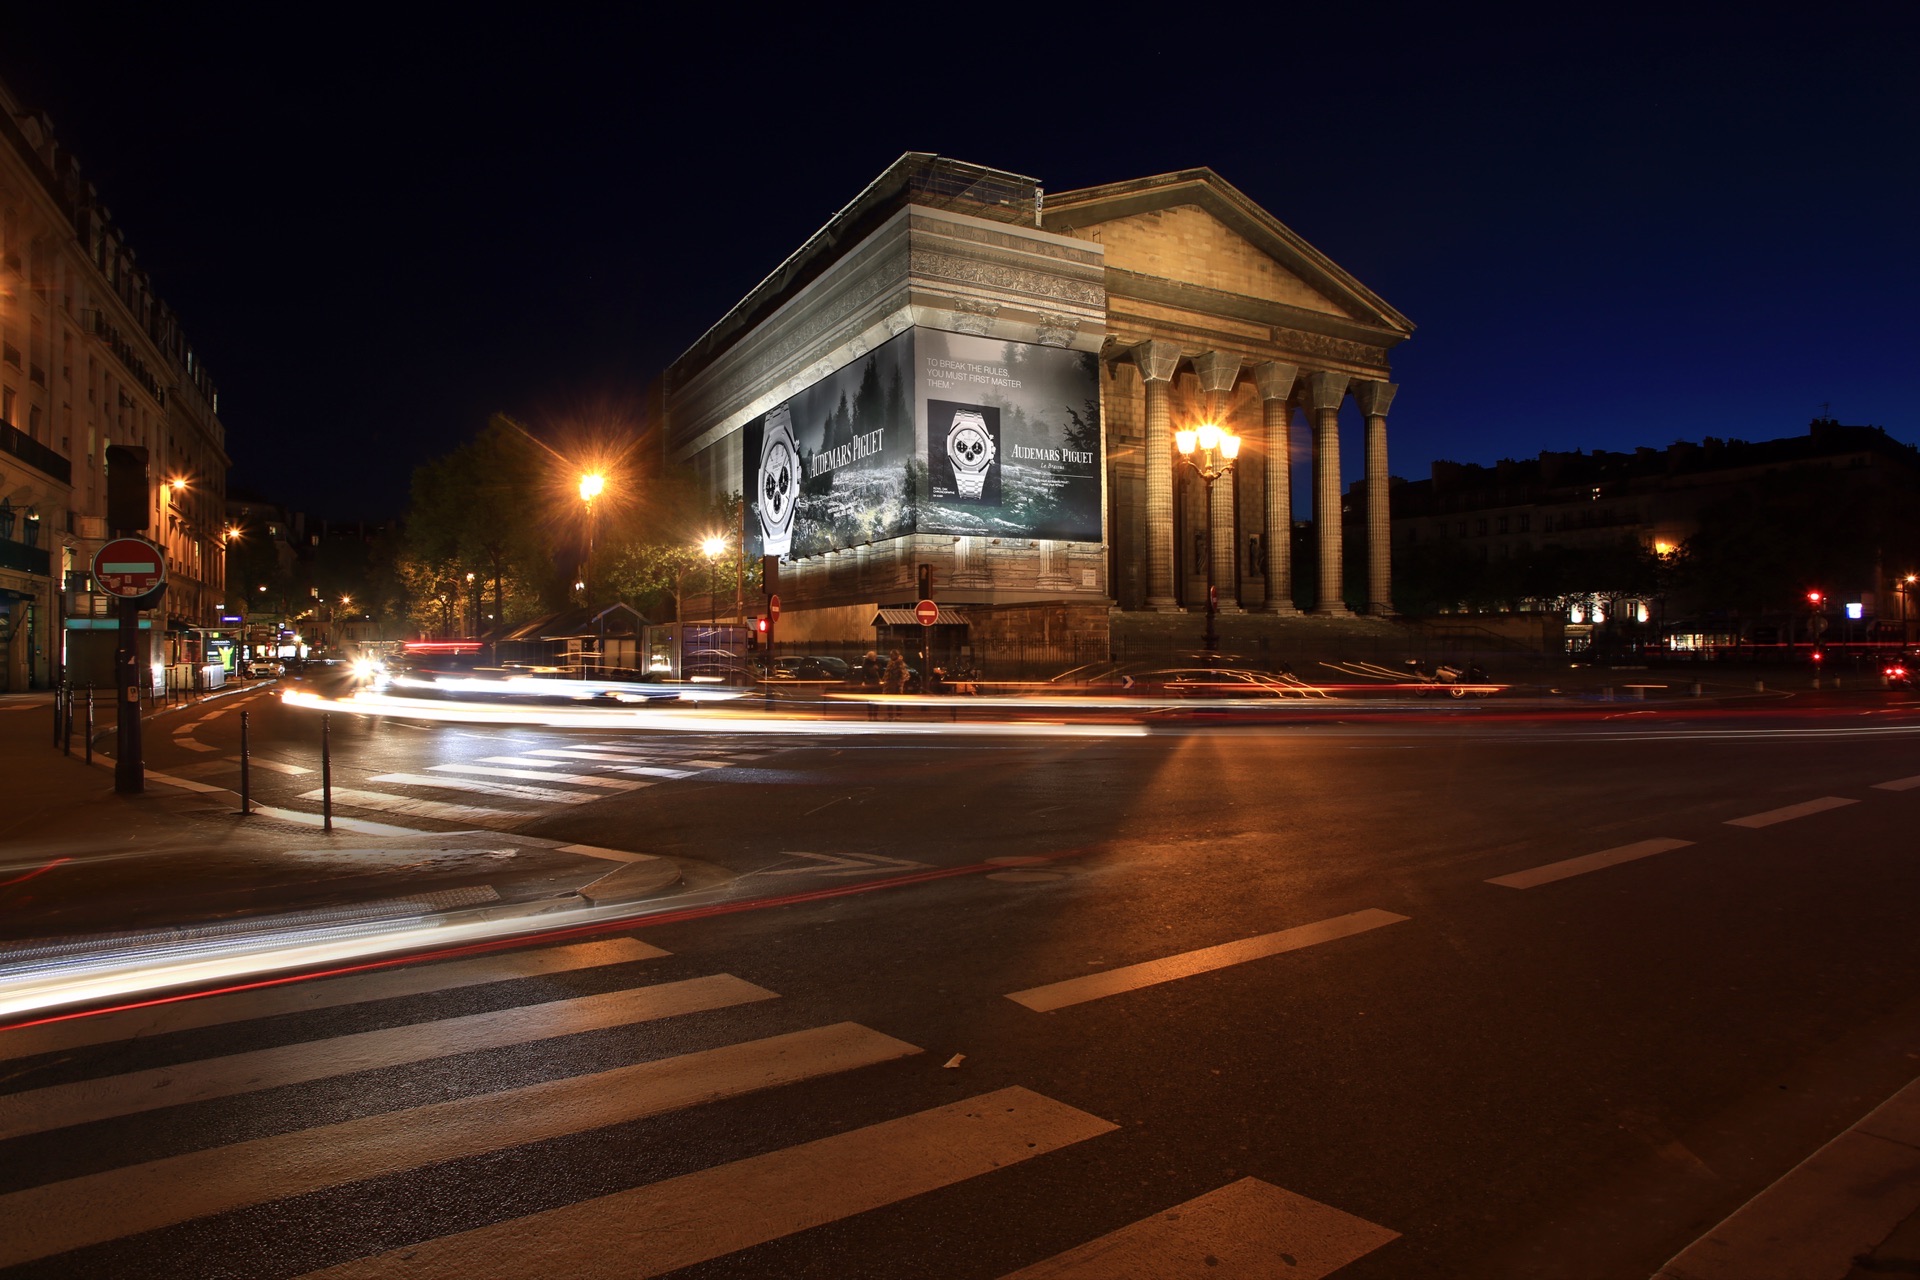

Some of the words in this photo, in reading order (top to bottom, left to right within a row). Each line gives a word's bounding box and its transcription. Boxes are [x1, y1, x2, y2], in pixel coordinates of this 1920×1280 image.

[926, 357, 938, 367] TO
[939, 359, 966, 370] BREAK
[967, 363, 982, 374] THE
[983, 365, 1010, 378] RULES,
[926, 368, 944, 378] YOU
[945, 370, 968, 381] MUST
[968, 374, 990, 384] FIRST
[991, 377, 1022, 388] MASTER
[810, 442, 852, 479] AUDEMARS
[852, 427, 885, 462] PIGUET
[1010, 443, 1060, 462] AUDEMARS
[1062, 448, 1094, 464] PIGUET
